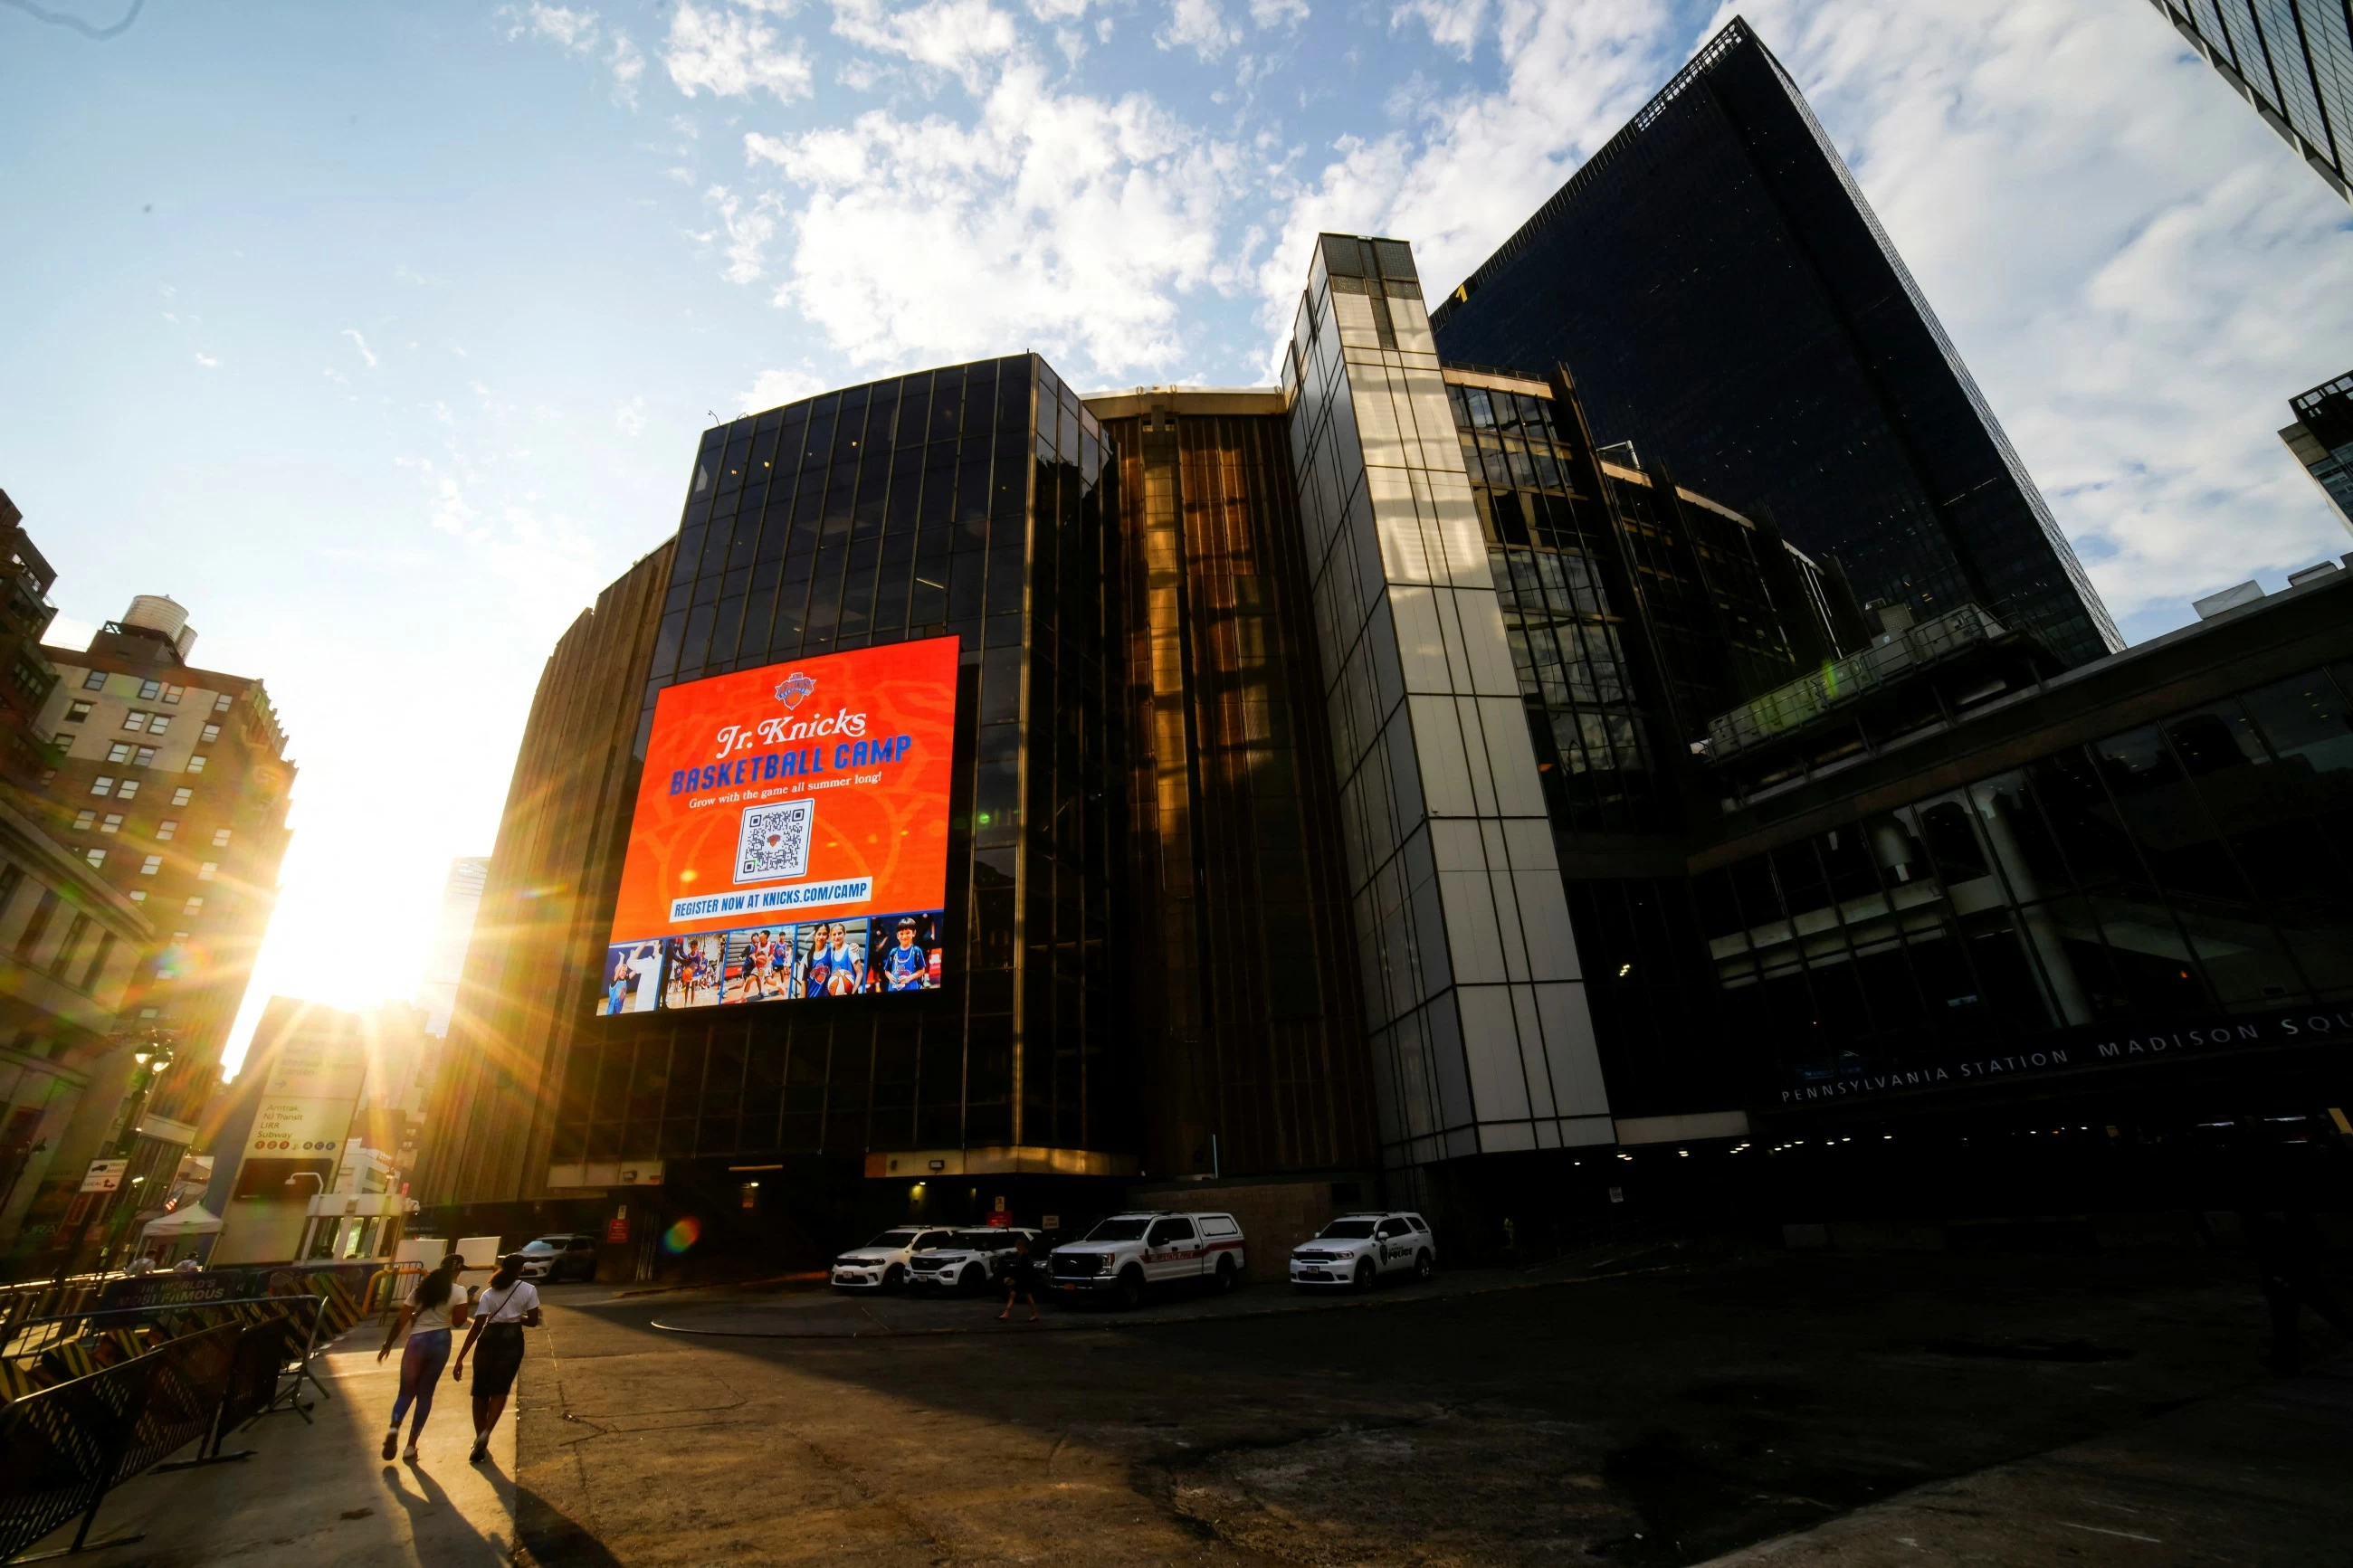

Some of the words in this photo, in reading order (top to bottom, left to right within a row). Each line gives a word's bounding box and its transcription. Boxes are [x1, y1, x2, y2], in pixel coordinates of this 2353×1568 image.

[716, 725, 753, 759] Jr.
[757, 708, 867, 746] Knicks
[670, 746, 824, 795] BASKETBALL
[834, 735, 912, 769] CAMP
[689, 797, 716, 809] Grow
[719, 792, 740, 803] with
[743, 789, 758, 801] the
[761, 786, 789, 801] game
[791, 782, 805, 793] all
[807, 777, 851, 791] summer
[854, 771, 881, 785] long!
[674, 898, 719, 917] REGISTER
[721, 897, 745, 911] NOW
[747, 894, 760, 908] AT
[762, 882, 867, 908] KNICKS.COM/CAMP
[1781, 1068, 1948, 1103] PENNSYLVANIA
[1960, 1050, 2068, 1077] STATION
[2098, 1024, 2259, 1058] MADISON
[257, 1131, 292, 1139] Subway
[1388, 1247, 1414, 1260] POLICE
[161, 1288, 225, 1303] FAMOUS
